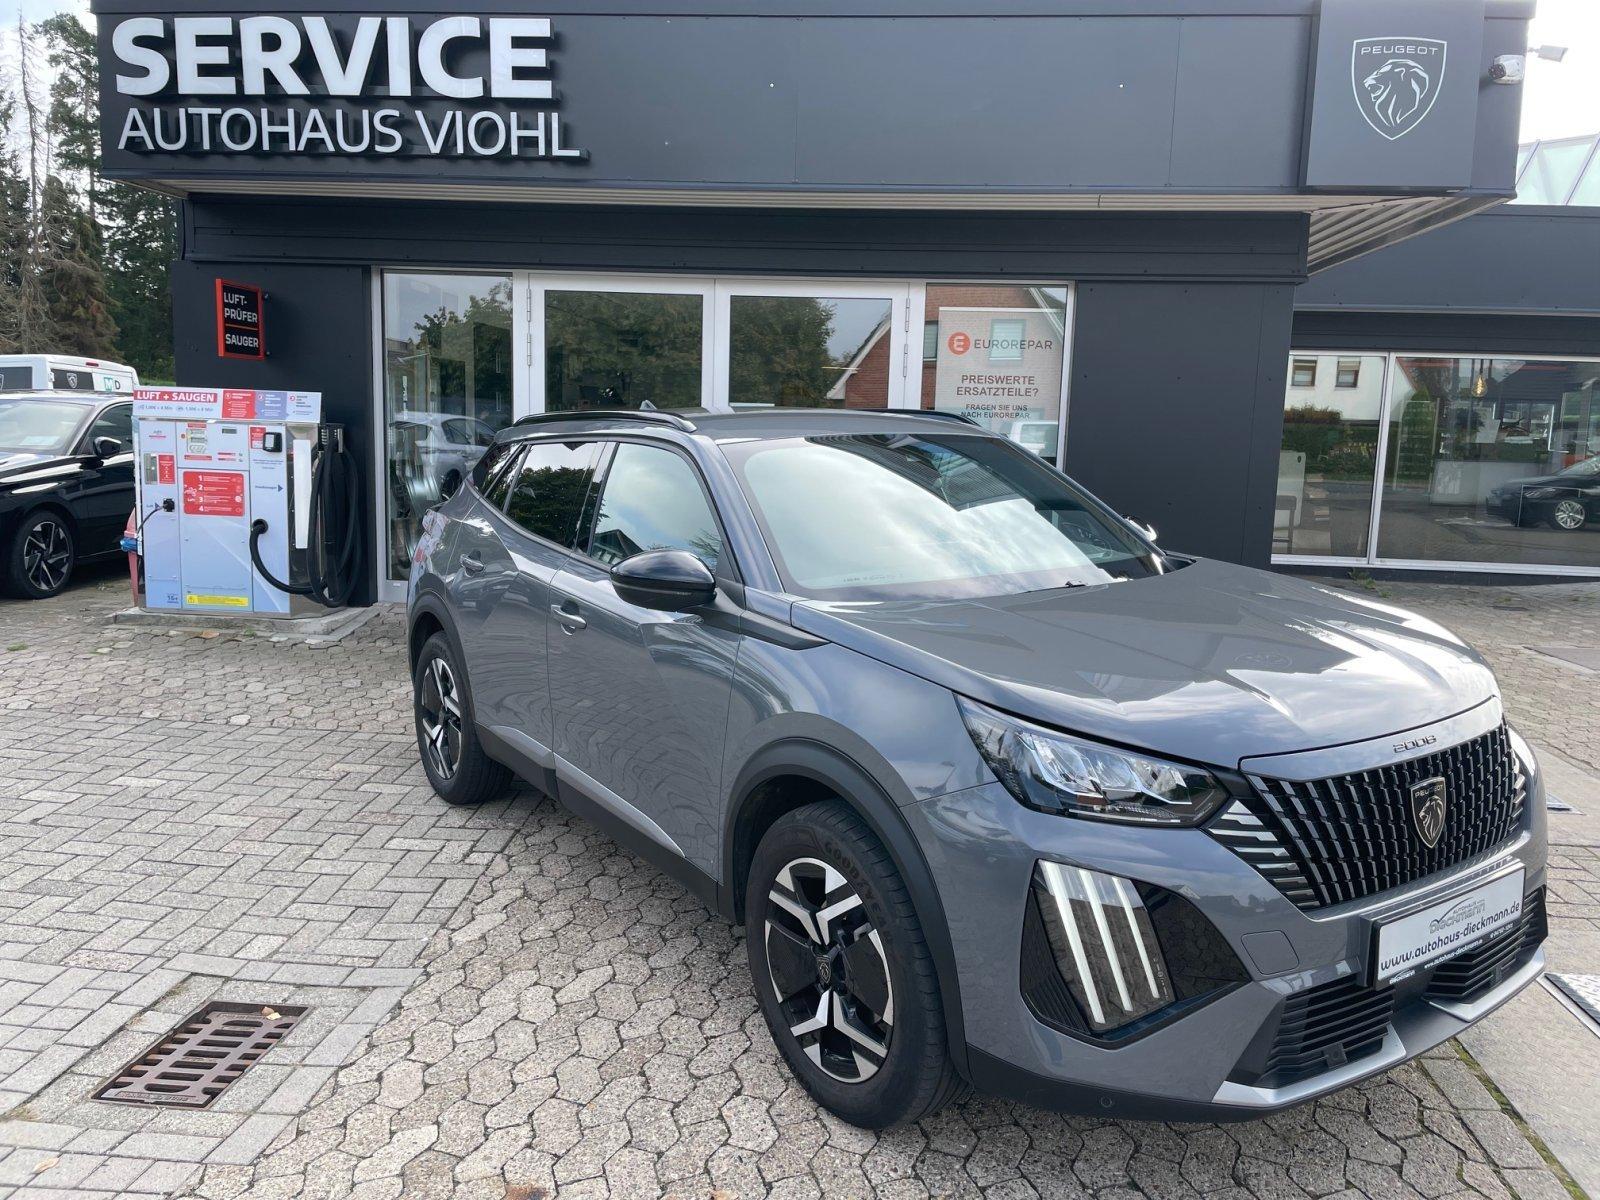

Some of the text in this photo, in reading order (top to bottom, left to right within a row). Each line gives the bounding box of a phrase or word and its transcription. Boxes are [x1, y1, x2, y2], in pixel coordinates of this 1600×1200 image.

[1361, 45, 1438, 55] PEUGEOT
[112, 16, 553, 99] SERVICE
[118, 107, 580, 157] AUTOHAUS VIOHL
[223, 292, 248, 306] LUFT-
[224, 307, 258, 323] PRÜFER
[225, 333, 259, 348] SAUGER
[974, 339, 1053, 350] EUROREPAR
[961, 374, 1035, 385] PREISWERTE
[137, 391, 161, 400] LUFT
[172, 392, 215, 402] SAUGEN
[956, 387, 1039, 397] ERSATZTEILE?
[965, 403, 996, 411] FRAGEN
[984, 411, 1030, 419] EUROREPAR
[1393, 735, 1437, 753] 2008
[1380, 900, 1520, 971] www.autohaus-dieckmann.de
